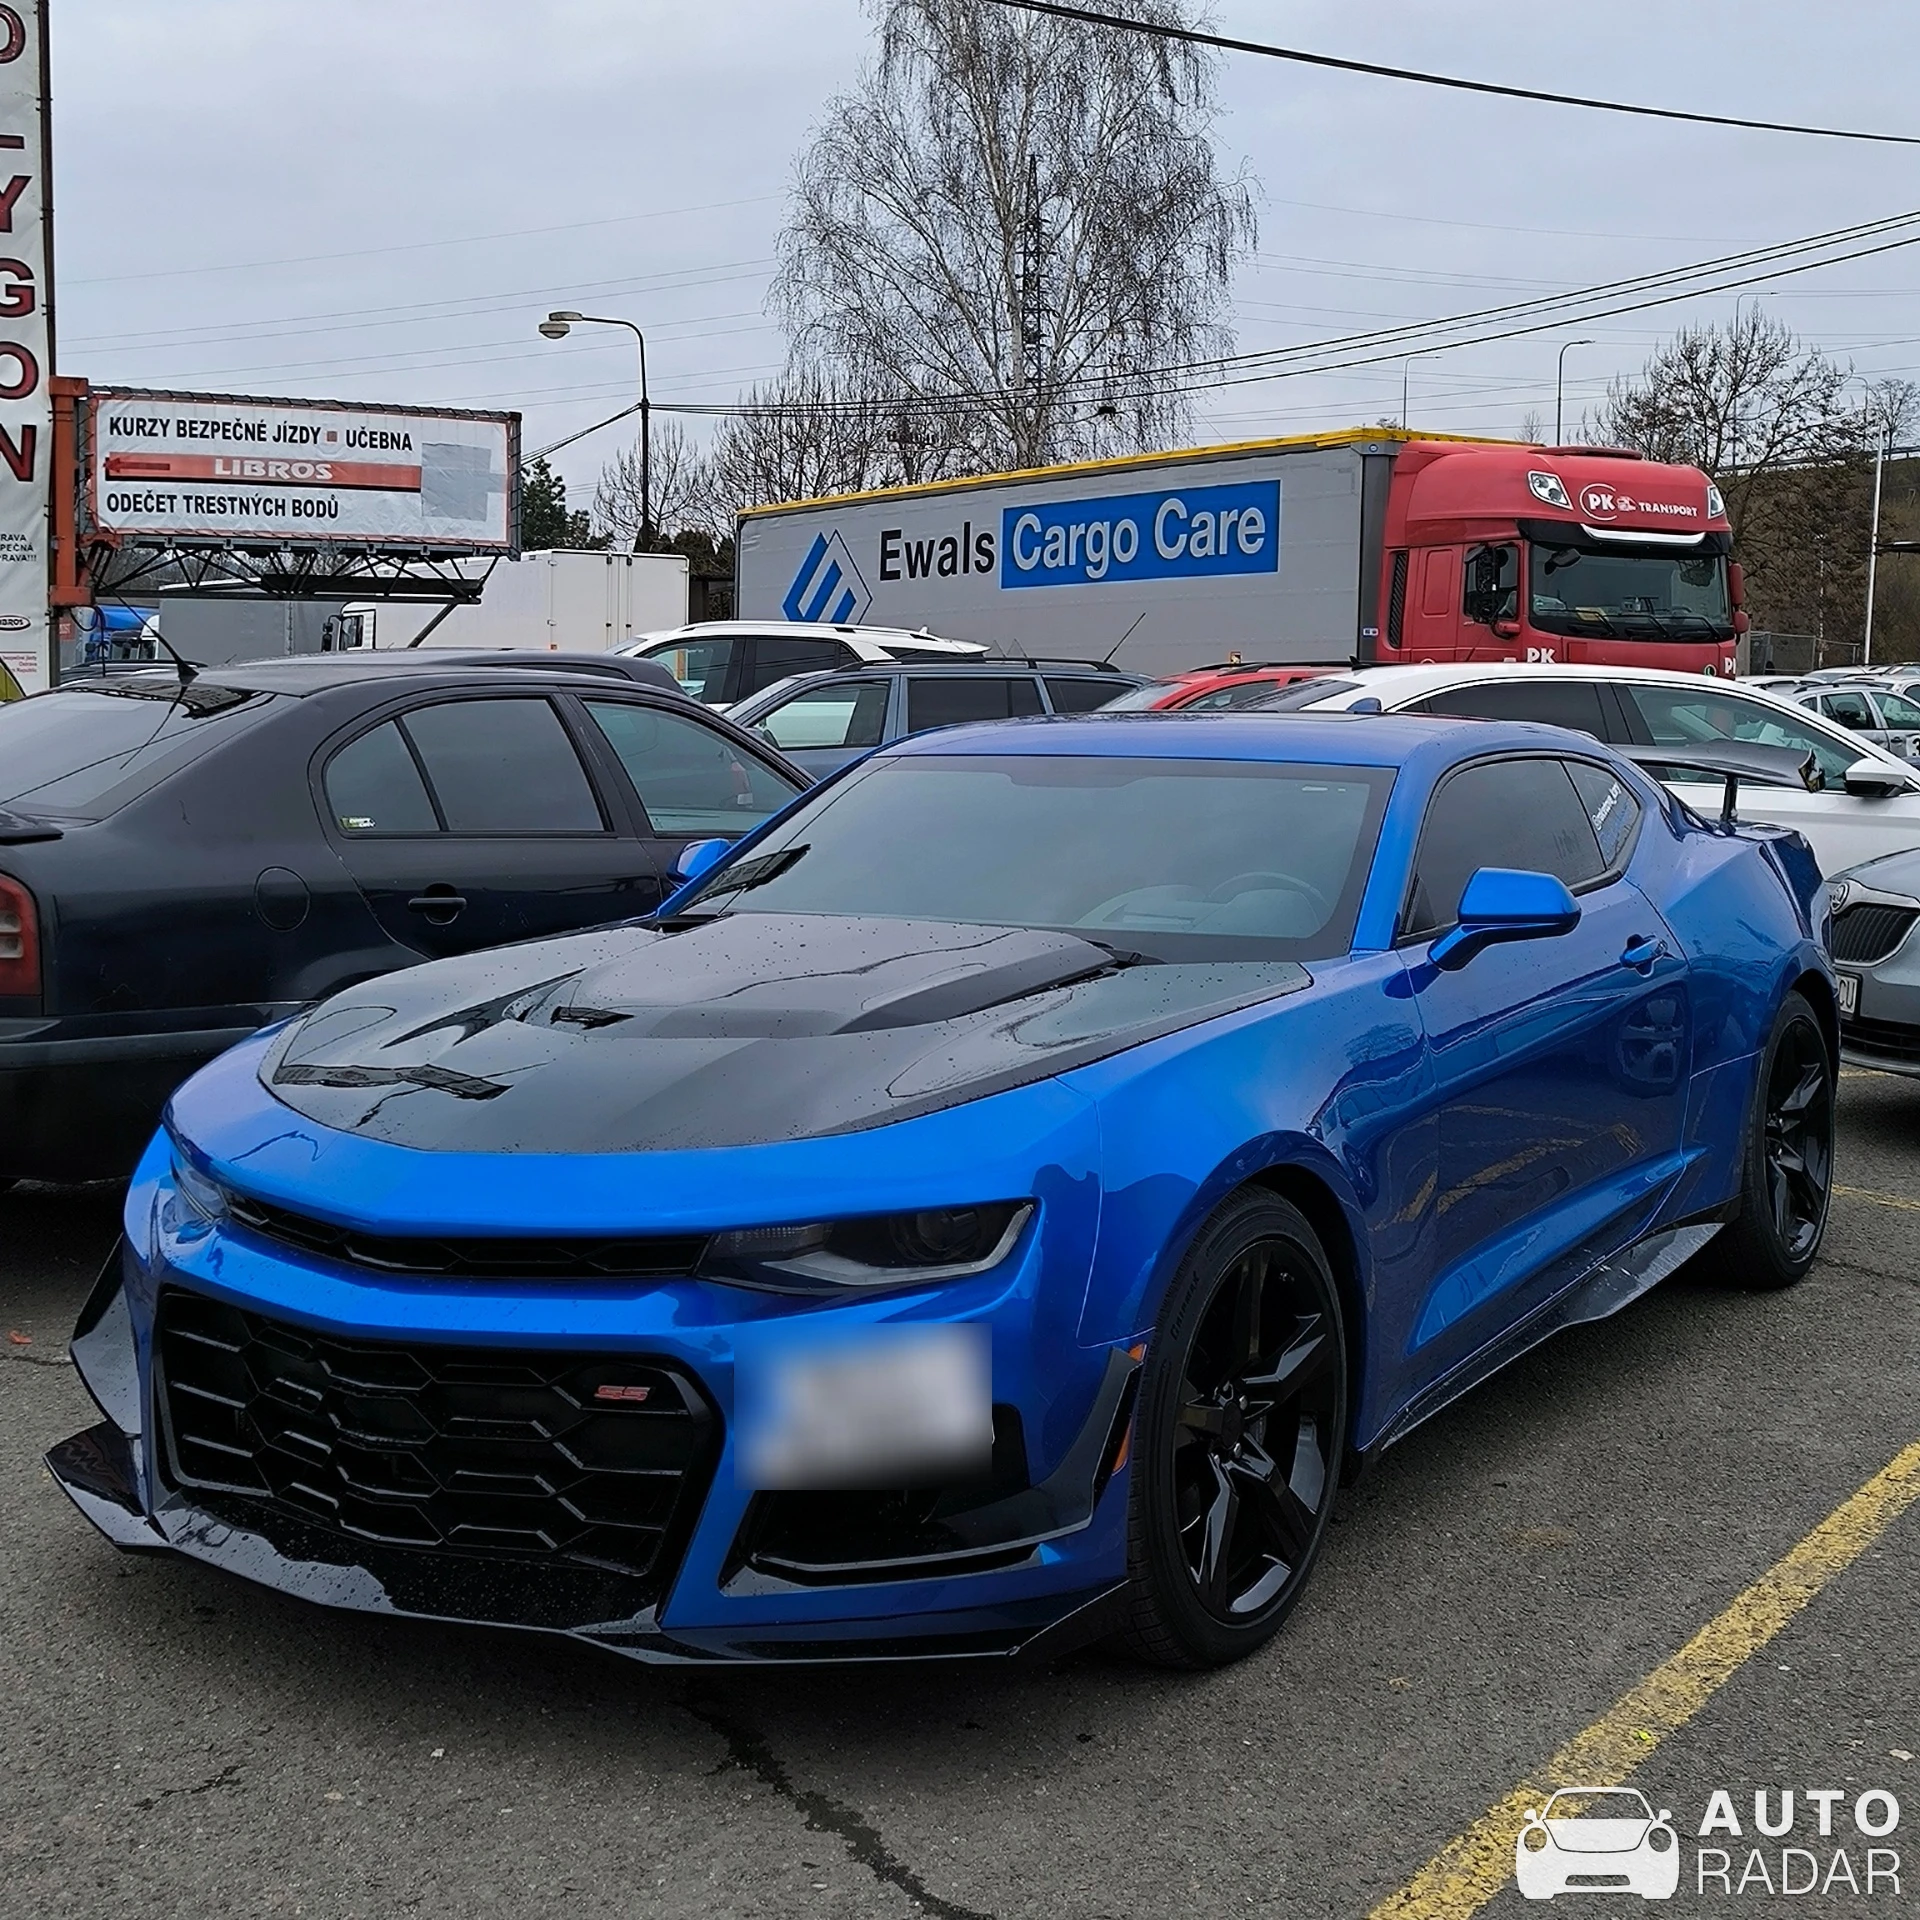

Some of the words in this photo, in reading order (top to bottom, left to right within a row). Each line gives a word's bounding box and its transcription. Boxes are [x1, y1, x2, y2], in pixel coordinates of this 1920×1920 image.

[0, 2, 39, 482] YGON
[109, 416, 171, 438] KURZY
[176, 417, 267, 442] BEZPEČNÉ
[272, 420, 322, 445] JÍZDY
[346, 426, 413, 451] UČEBNA
[214, 458, 333, 480] LIBROS
[106, 489, 178, 513] ODEČET
[183, 493, 286, 516] TRESTNÝCH
[292, 493, 339, 519] BODŮ
[1587, 493, 1616, 511] PK
[1638, 501, 1698, 517] TRANSPORT
[879, 521, 995, 582] Ewals
[1012, 512, 1140, 579] Cargo
[1154, 497, 1266, 561] Care
[0, 554, 37, 562] RAVA!!!
[1526, 647, 1556, 664] PK
[594, 1385, 652, 1401] SS
